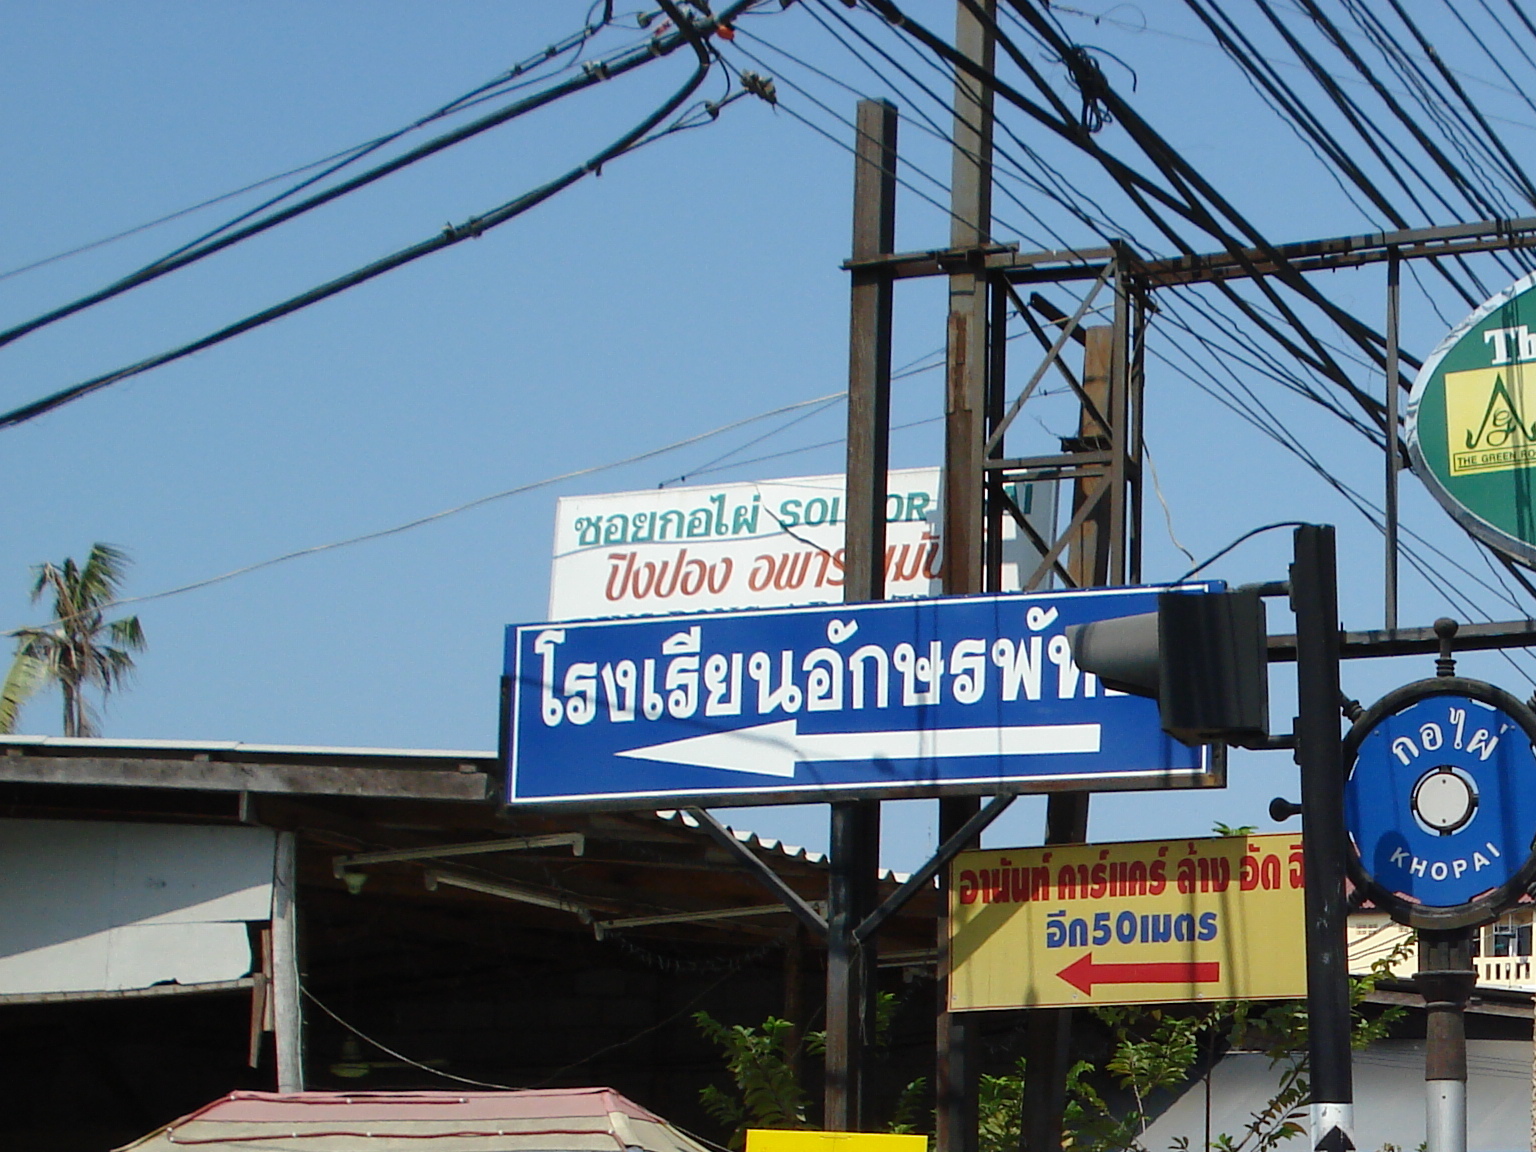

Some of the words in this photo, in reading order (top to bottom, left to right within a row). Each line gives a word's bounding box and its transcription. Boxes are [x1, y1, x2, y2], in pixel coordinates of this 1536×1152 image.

[1457, 455, 1478, 467] THE
[1481, 451, 1517, 464] GREEN
[574, 493, 760, 547] ซอยกอไผ่
[779, 496, 840, 528] SOI
[605, 547, 732, 602] ปิงปอง
[534, 606, 1132, 728] โรงเรียนอักษรพัท
[1391, 707, 1509, 767] กอไผ่
[1058, 845, 1170, 901] คาร์แคร์
[1239, 843, 1281, 892] อัด
[1389, 842, 1501, 881] KHOPAI
